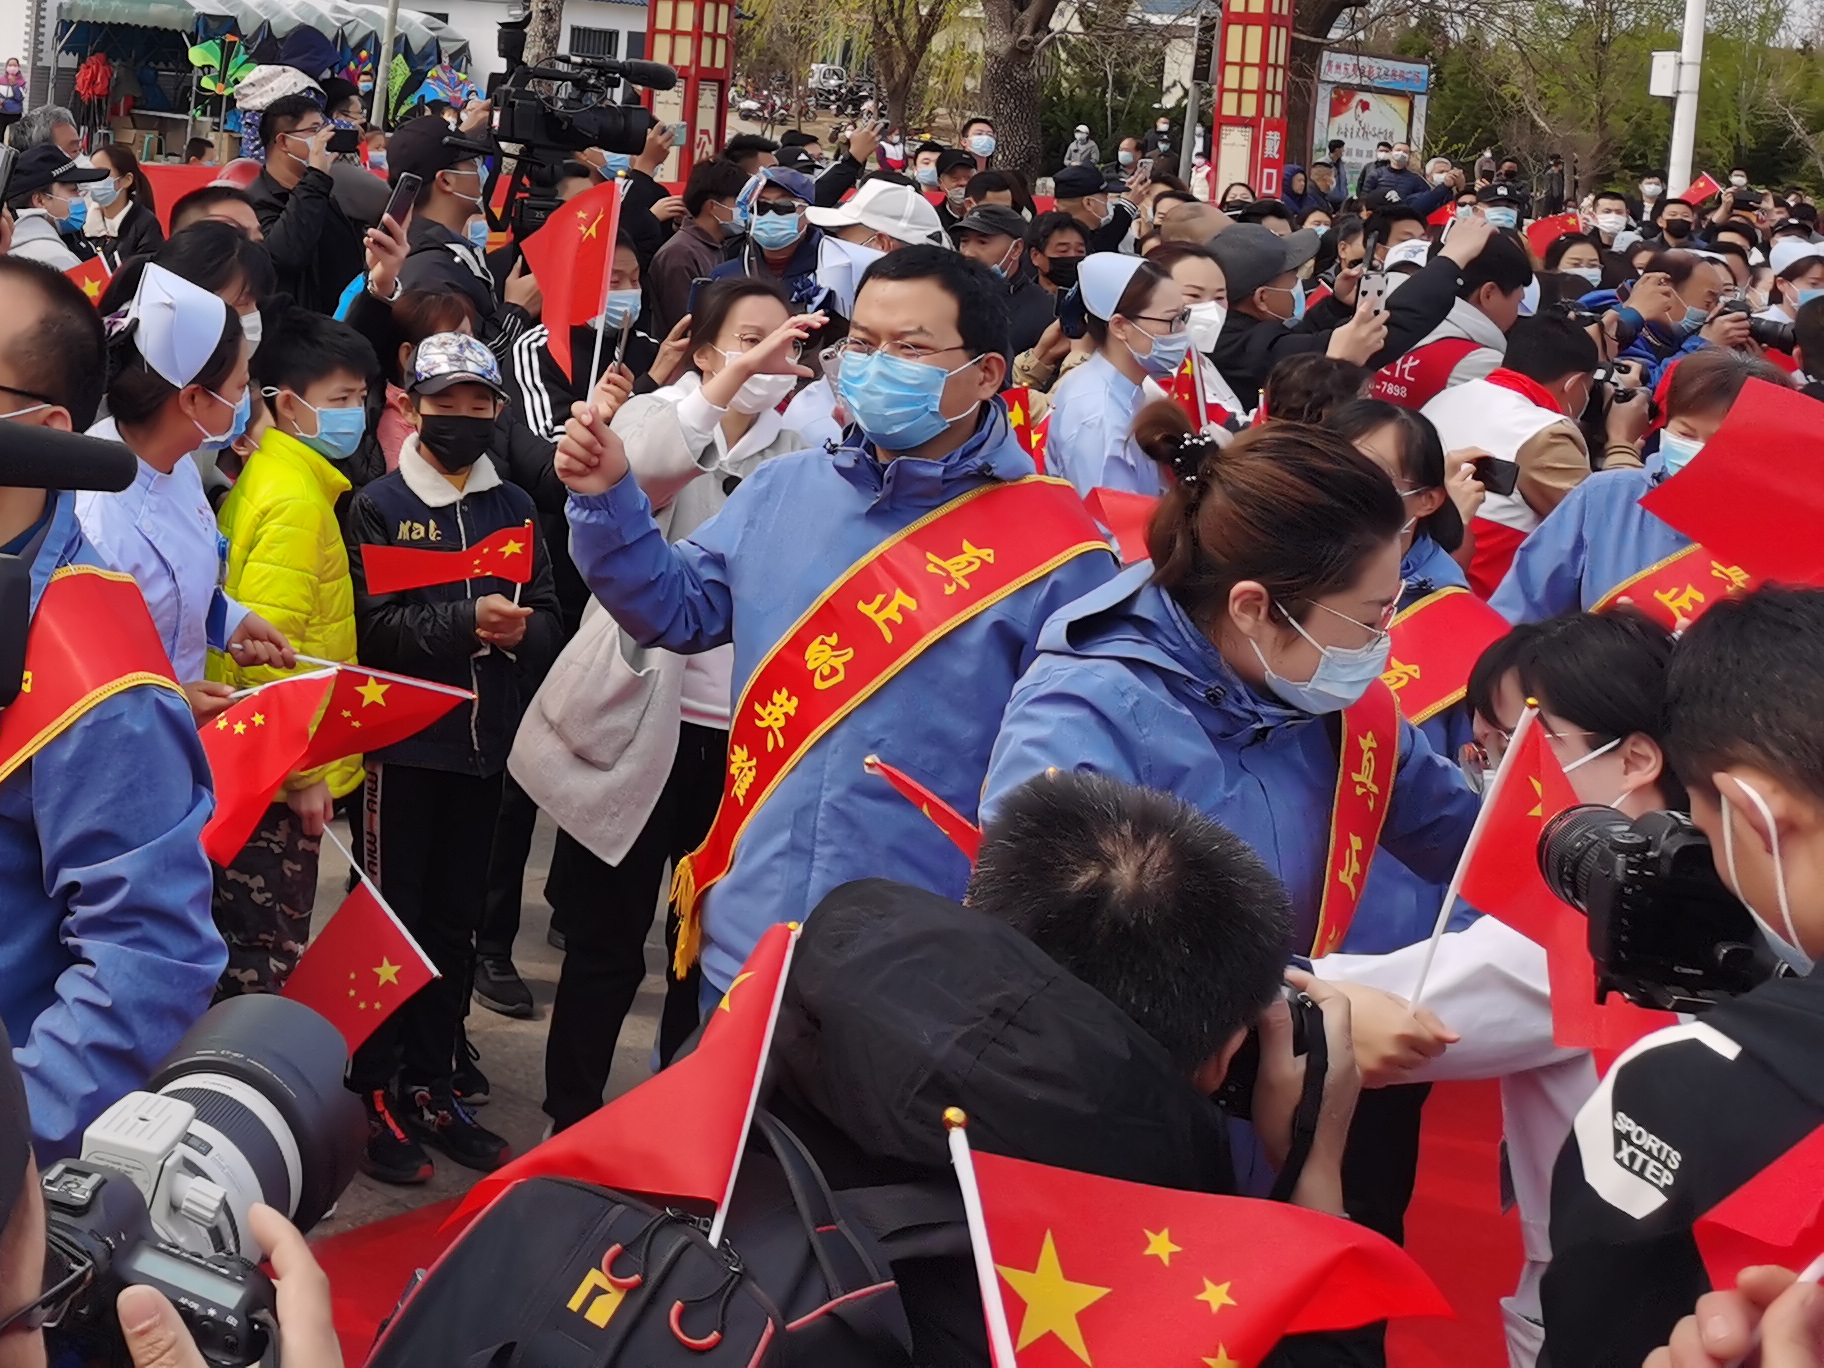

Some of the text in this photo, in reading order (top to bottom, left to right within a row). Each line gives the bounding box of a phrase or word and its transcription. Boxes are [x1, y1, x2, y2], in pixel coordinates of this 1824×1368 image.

[729, 538, 996, 807] 真正的英雄
[1612, 1109, 1683, 1172] SPORTS
[1613, 1139, 1674, 1191] XTEP
